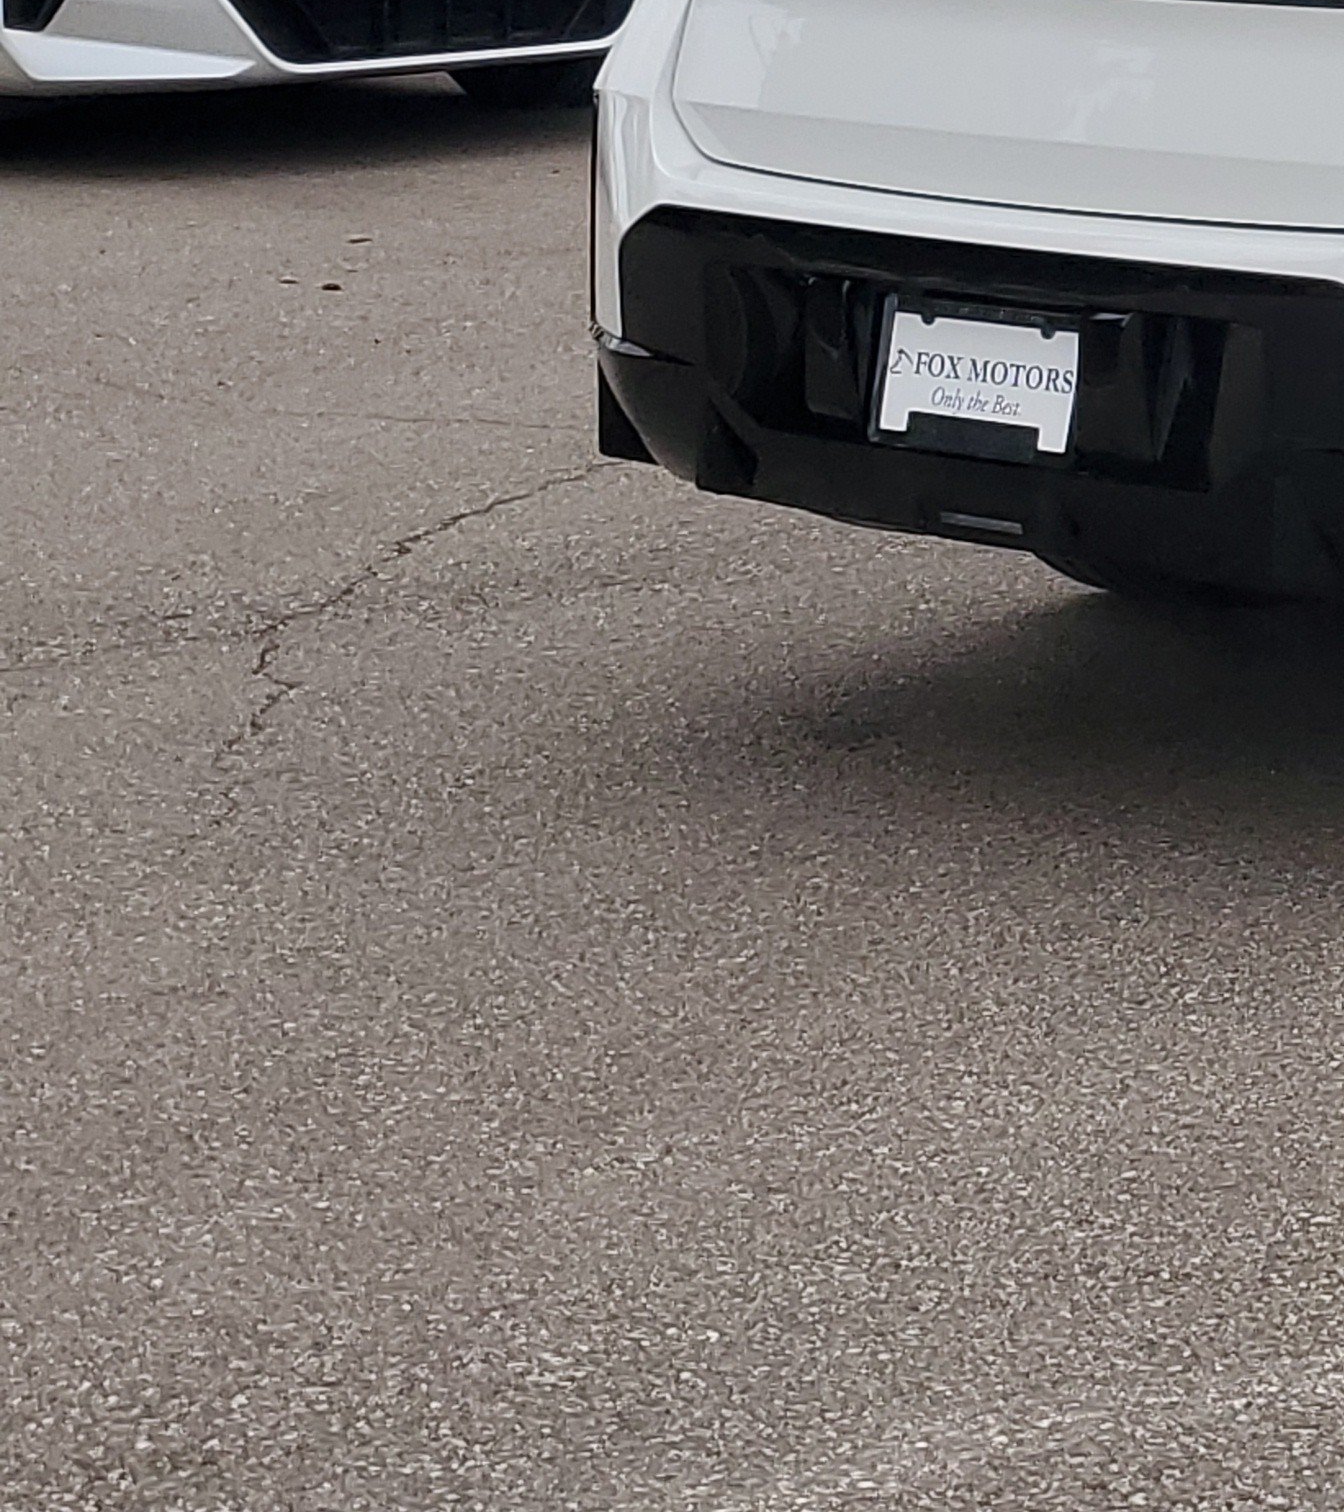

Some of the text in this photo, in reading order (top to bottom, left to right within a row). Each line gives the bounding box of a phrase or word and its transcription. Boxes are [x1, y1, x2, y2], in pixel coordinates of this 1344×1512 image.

[914, 351, 1075, 395] FOX MOTORS
[931, 386, 965, 415] Only
[966, 390, 990, 412] the
